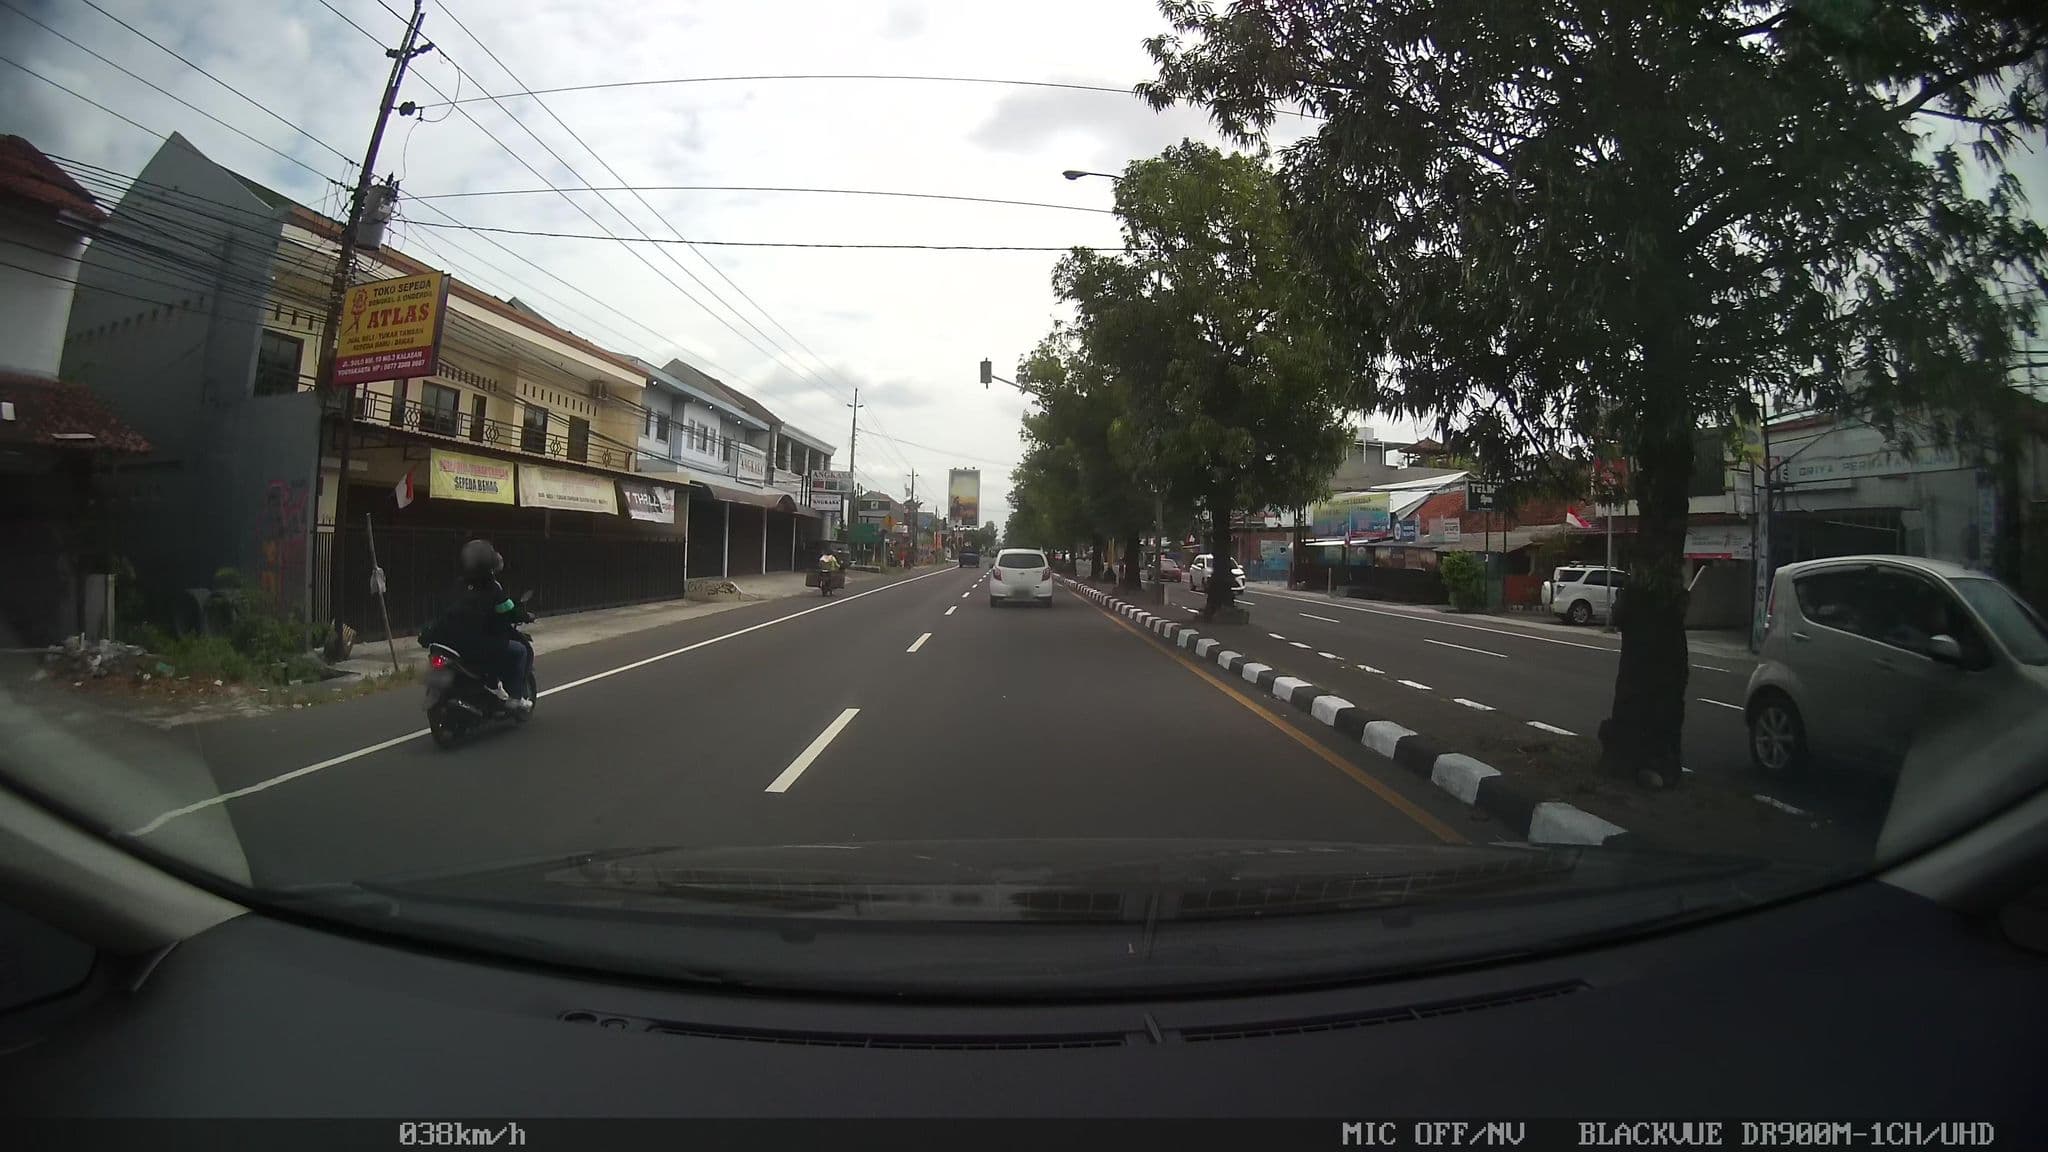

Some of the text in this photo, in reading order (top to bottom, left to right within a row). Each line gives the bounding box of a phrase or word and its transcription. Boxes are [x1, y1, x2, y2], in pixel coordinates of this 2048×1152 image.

[374, 280, 431, 298] TOKO SEPEDA
[367, 303, 430, 329] ATLAS
